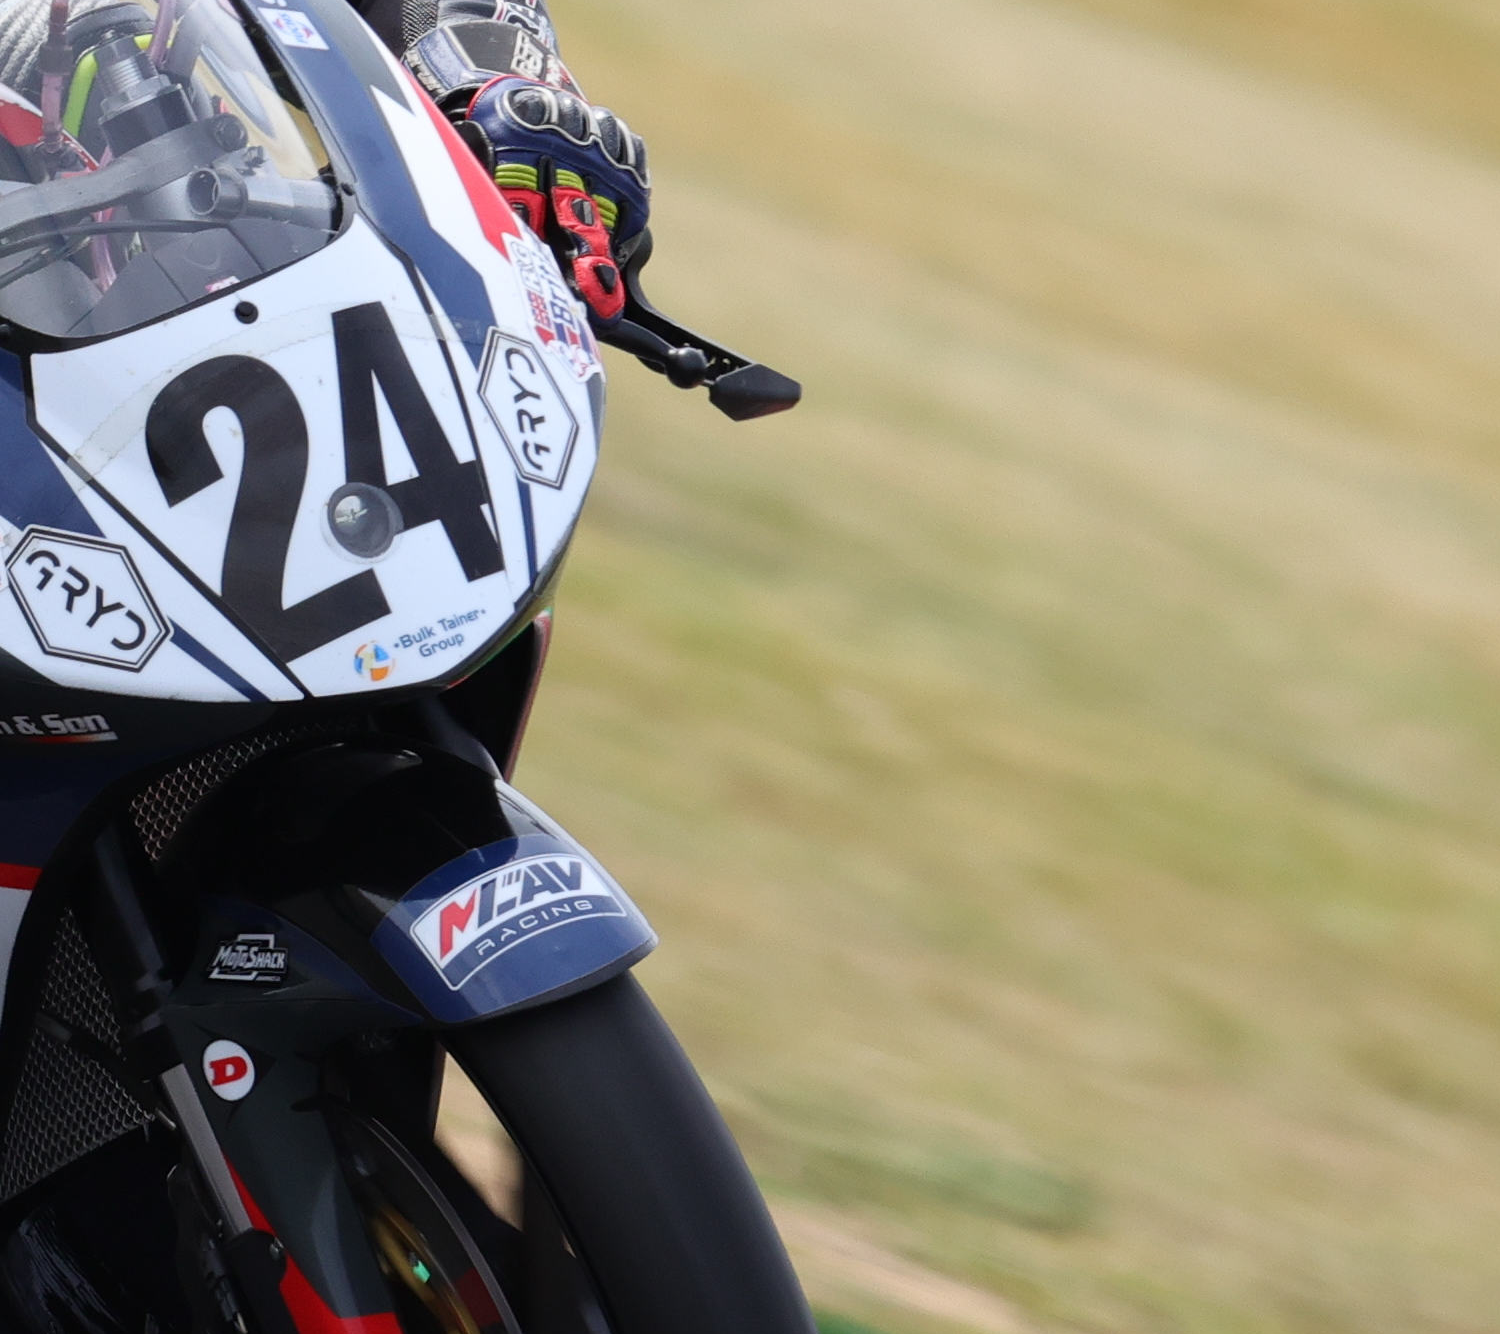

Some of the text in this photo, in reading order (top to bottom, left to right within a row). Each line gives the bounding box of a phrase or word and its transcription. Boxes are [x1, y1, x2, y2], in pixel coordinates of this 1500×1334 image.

[145, 300, 507, 665] 24
[419, 632, 465, 659] Group
[13, 715, 44, 735] &
[42, 714, 110, 735] Son
[476, 897, 594, 957] RACING
[209, 1056, 248, 1087] D
